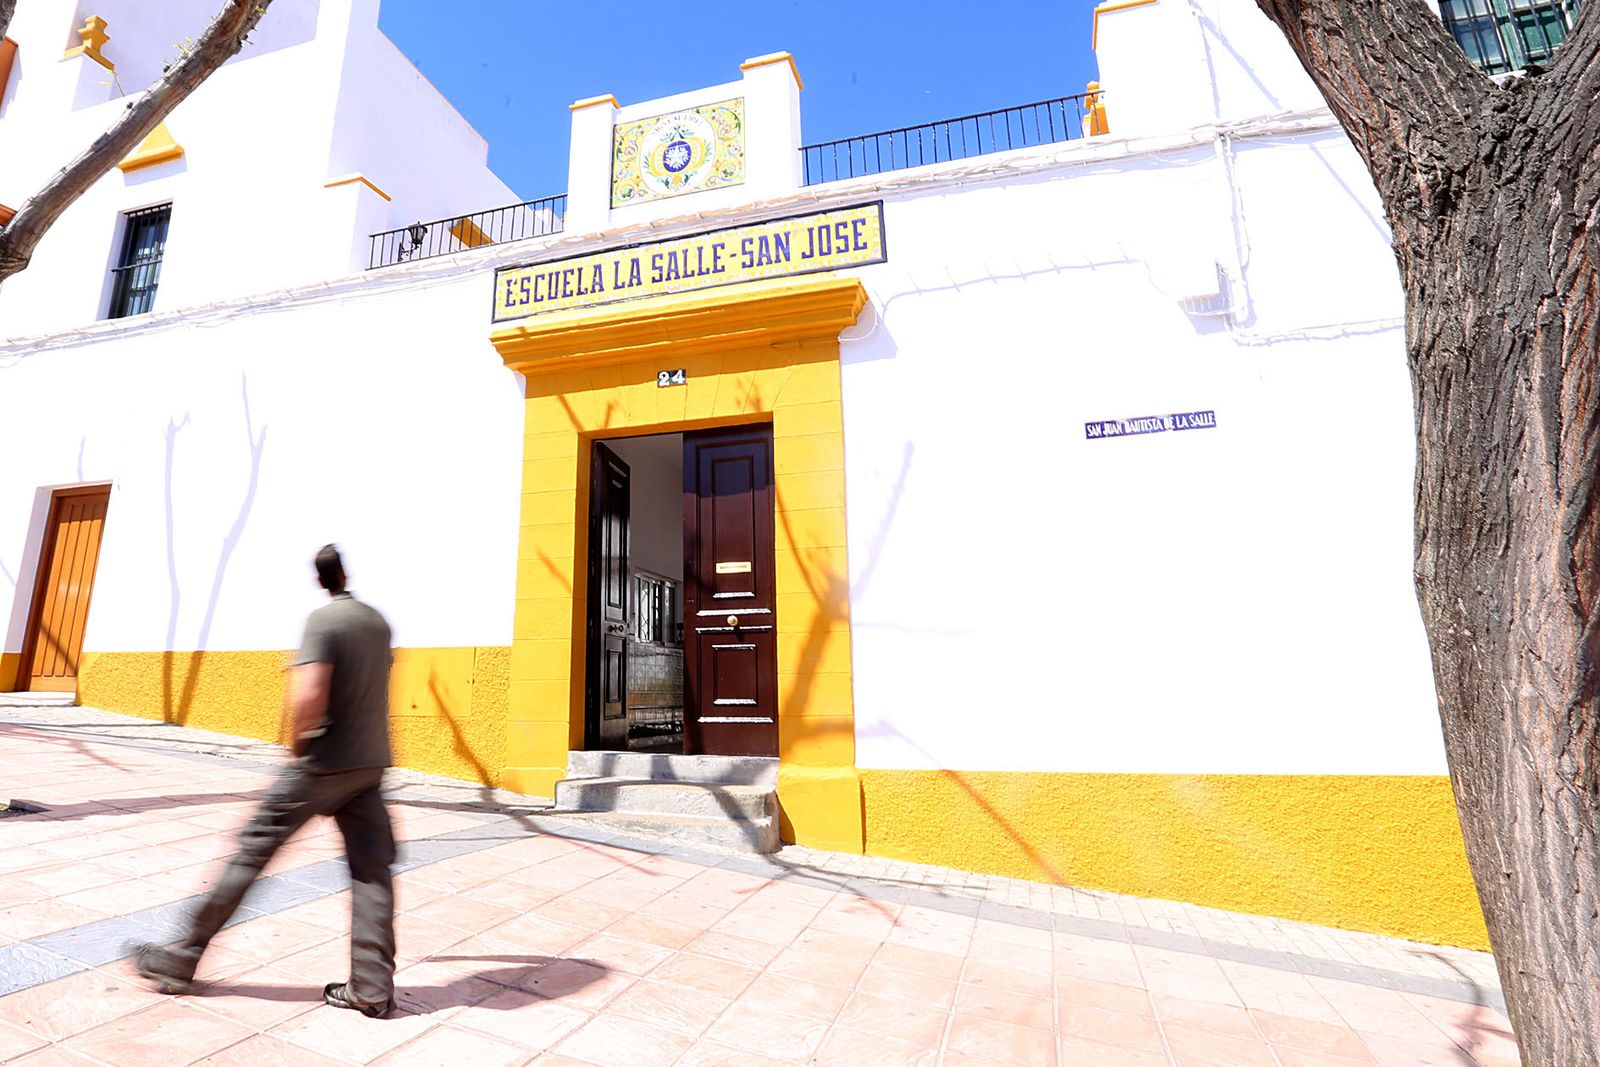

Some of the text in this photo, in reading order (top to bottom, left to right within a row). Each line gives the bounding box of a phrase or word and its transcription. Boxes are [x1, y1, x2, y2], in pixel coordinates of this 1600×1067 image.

[504, 263, 605, 307] ESCUELA
[613, 257, 643, 290] LA
[801, 218, 868, 260] JOSE
[658, 369, 686, 387] 24
[1087, 412, 1215, 437] SAN JUAN BAUTISTA DE LA SALLE
